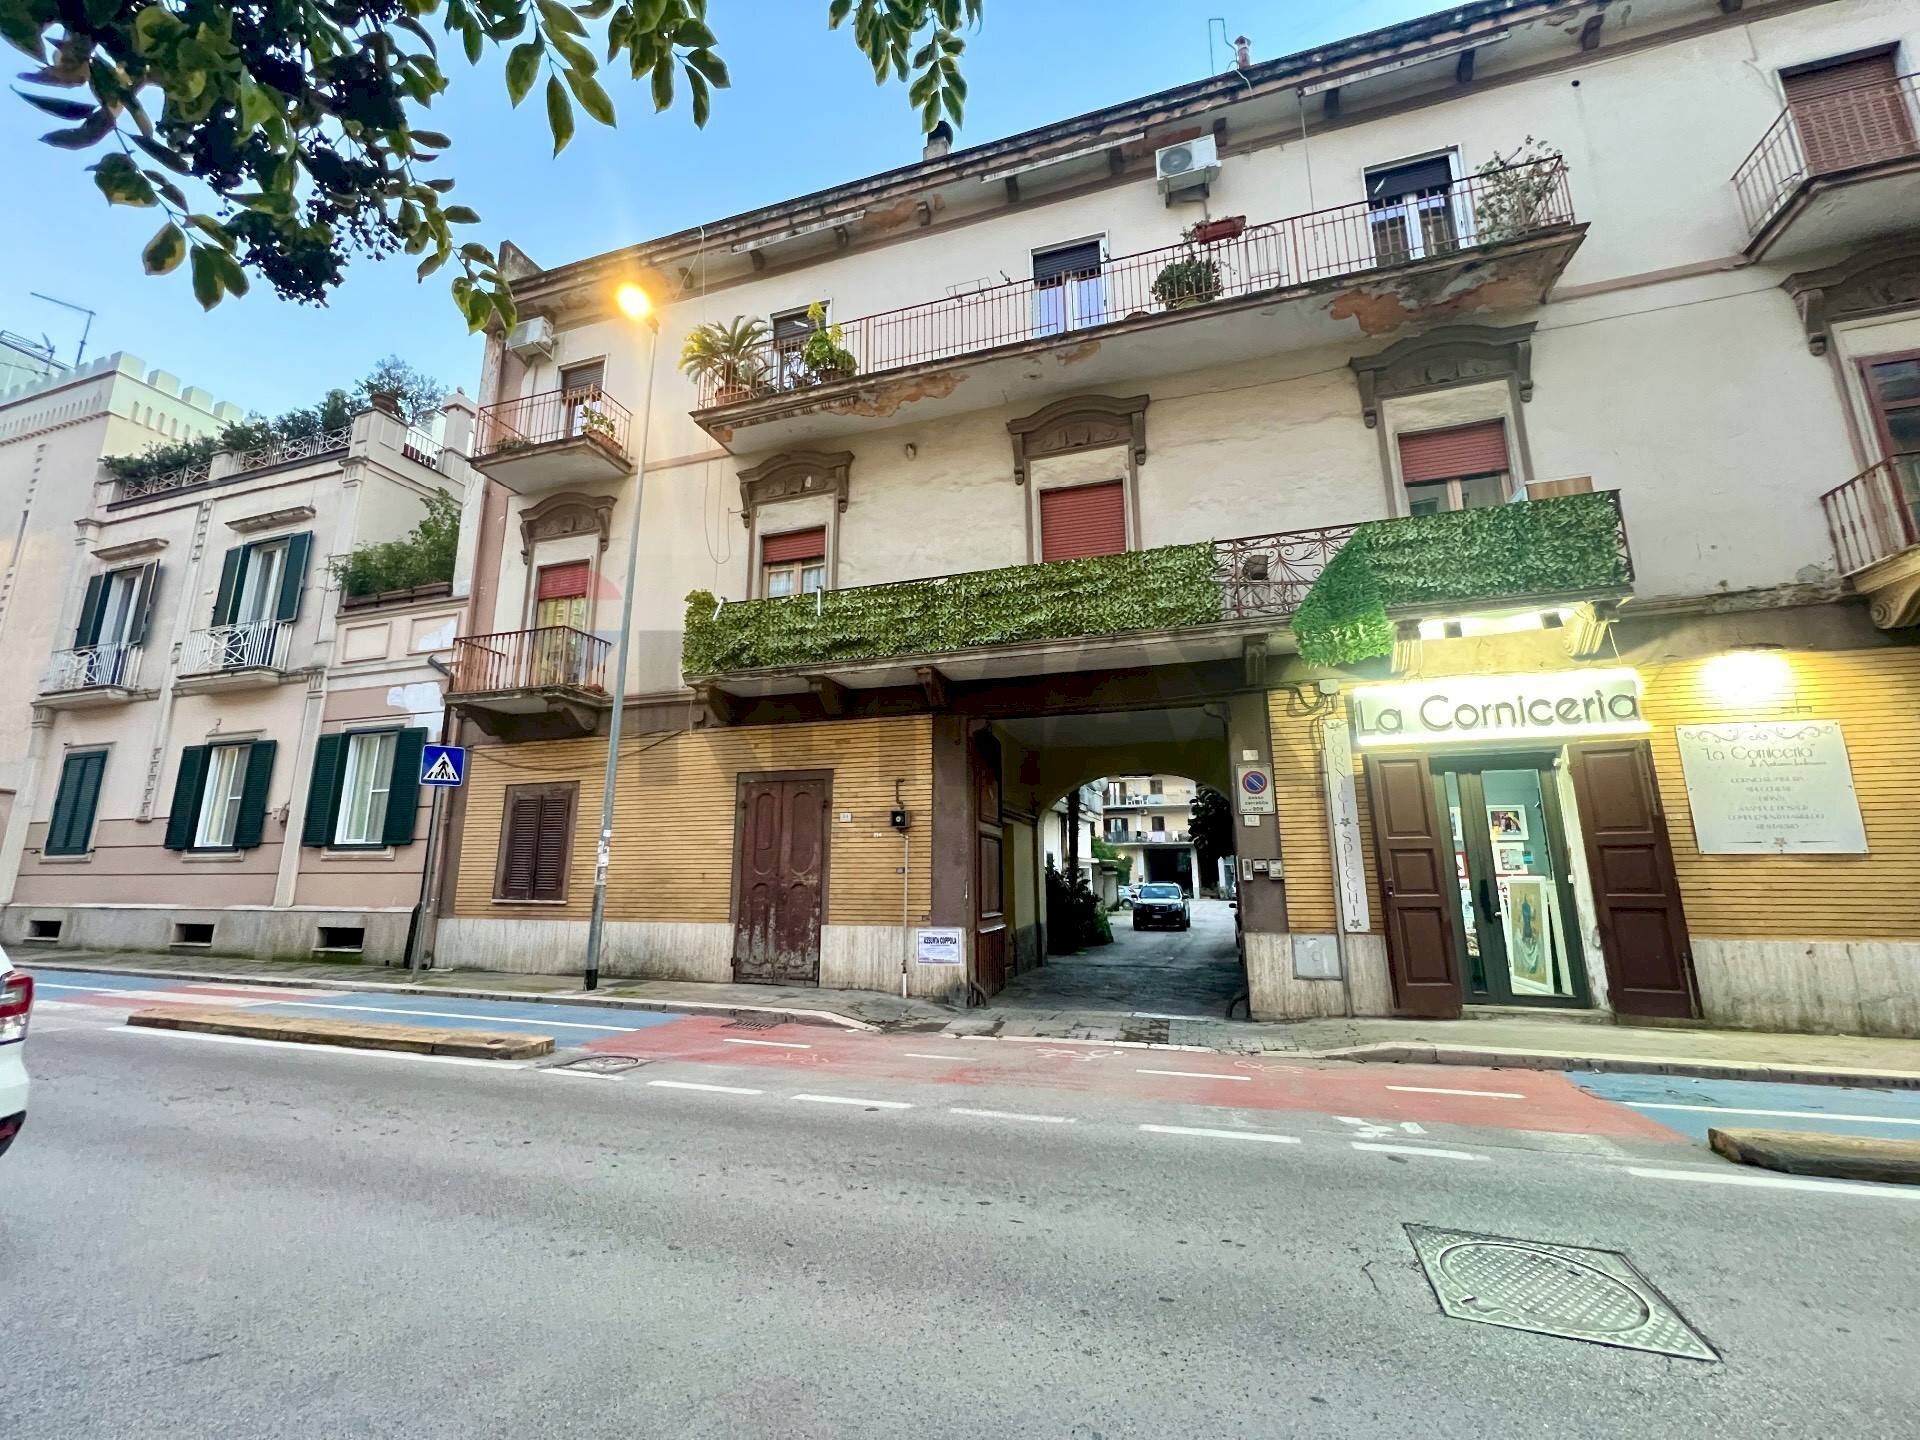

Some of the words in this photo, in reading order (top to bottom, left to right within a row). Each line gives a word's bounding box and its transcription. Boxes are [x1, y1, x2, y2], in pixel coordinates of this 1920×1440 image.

[1355, 700, 1403, 736] La
[1419, 690, 1640, 732] Corniceria
[1342, 832, 1358, 916] SPECCHI
[940, 936, 957, 945] COPPOLA
